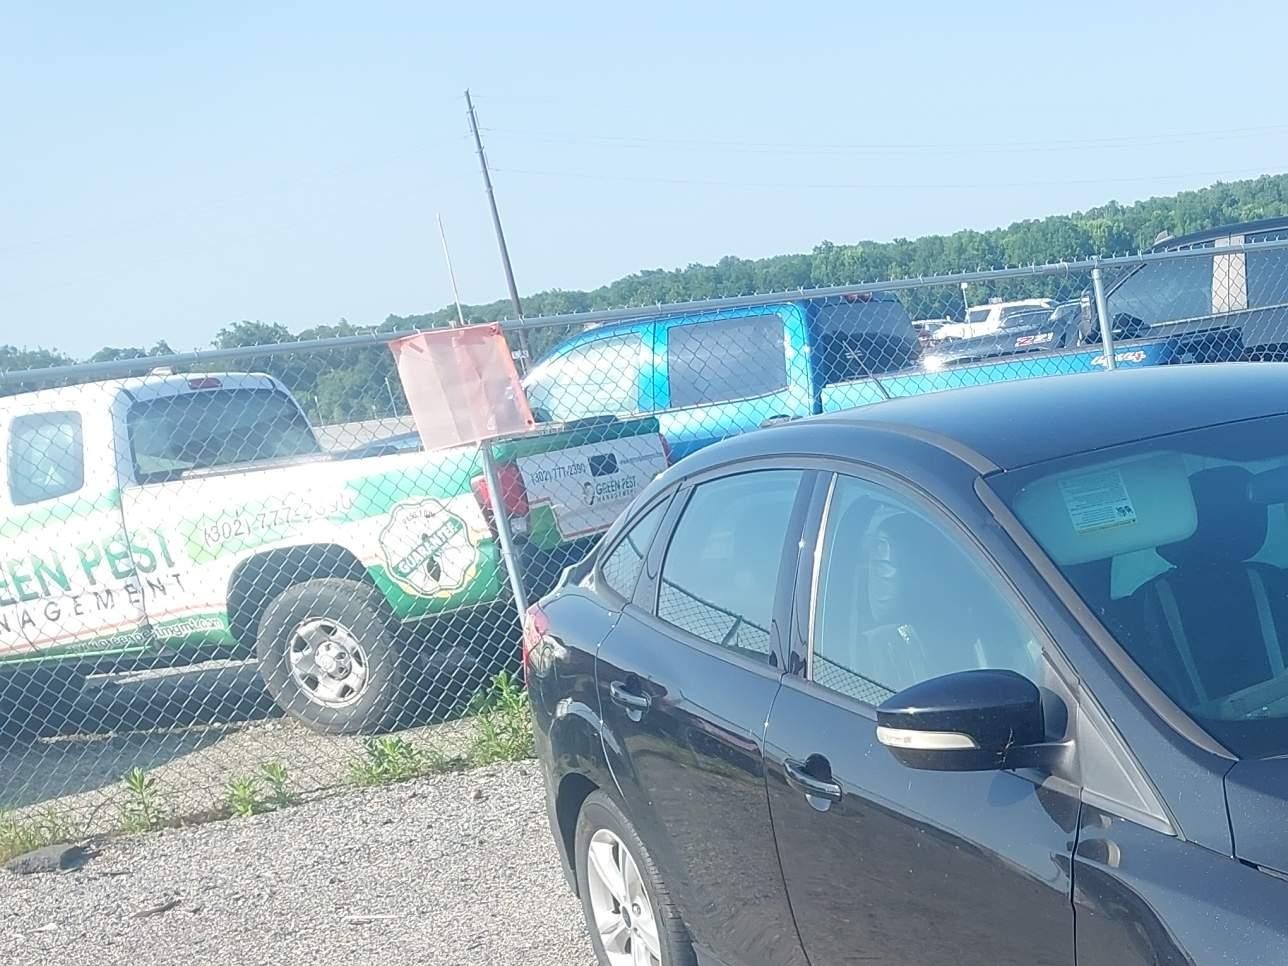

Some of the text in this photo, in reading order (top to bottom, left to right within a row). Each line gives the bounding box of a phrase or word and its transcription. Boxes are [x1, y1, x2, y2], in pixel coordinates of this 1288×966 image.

[595, 475, 637, 496] GREEN PEST
[203, 518, 252, 549] (302)
